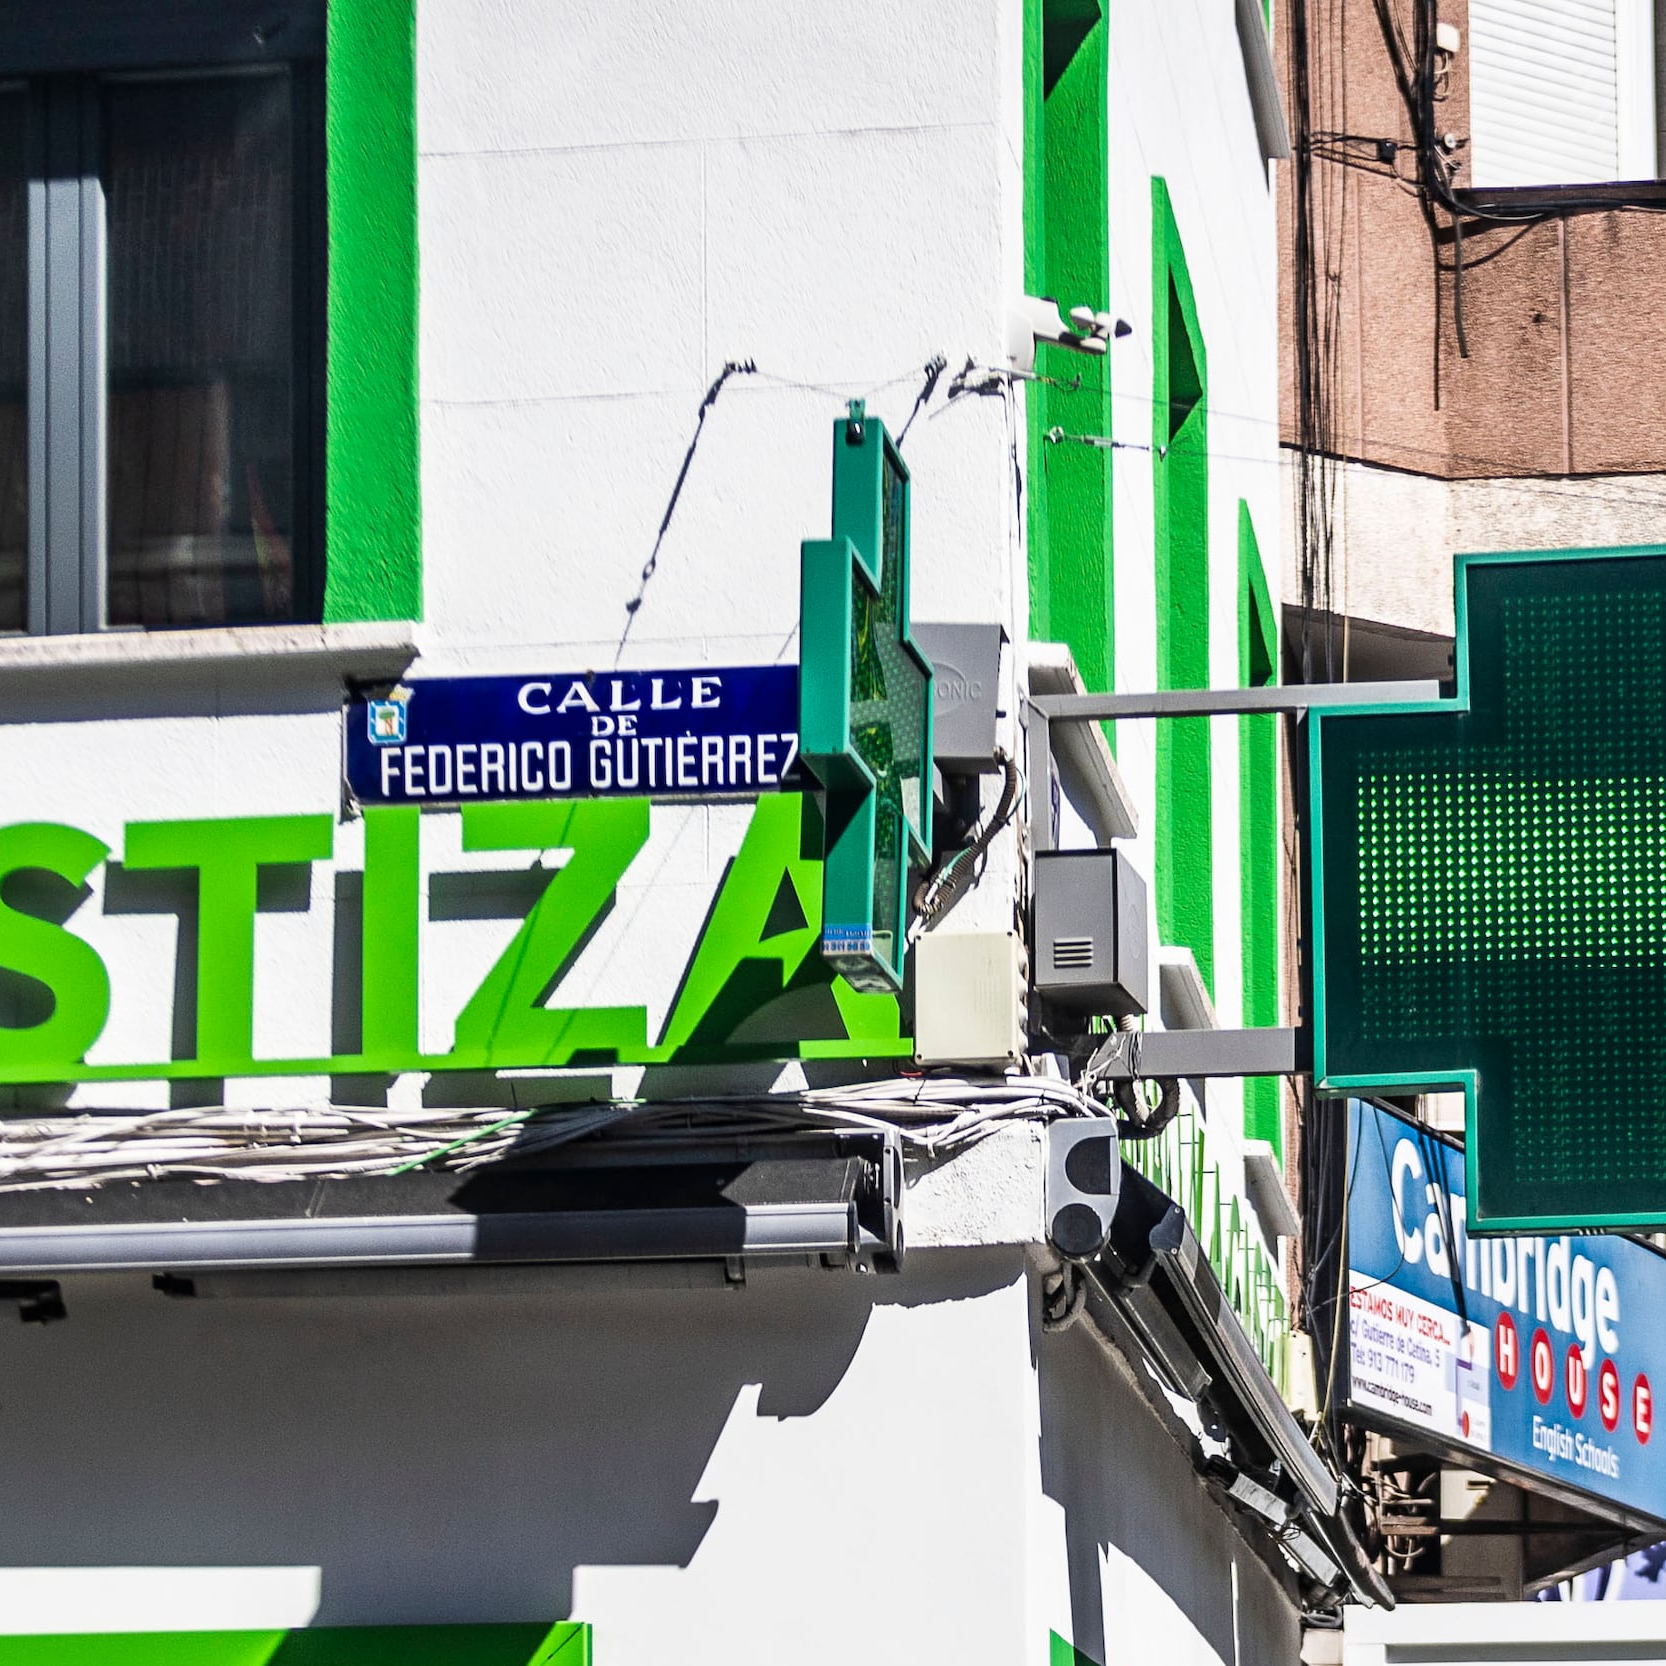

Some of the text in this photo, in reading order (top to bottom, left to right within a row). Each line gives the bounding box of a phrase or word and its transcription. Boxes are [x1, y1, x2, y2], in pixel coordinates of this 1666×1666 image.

[517, 675, 722, 715] CALLE
[591, 714, 638, 737] DE
[380, 740, 572, 797] FEDERICO
[1350, 1286, 1393, 1322] ESTAMOS
[1395, 1302, 1414, 1328] MUY
[1499, 1324, 1651, 1434] HOUSE
[1533, 1414, 1574, 1461] English
[1575, 1432, 1620, 1479] Schools
